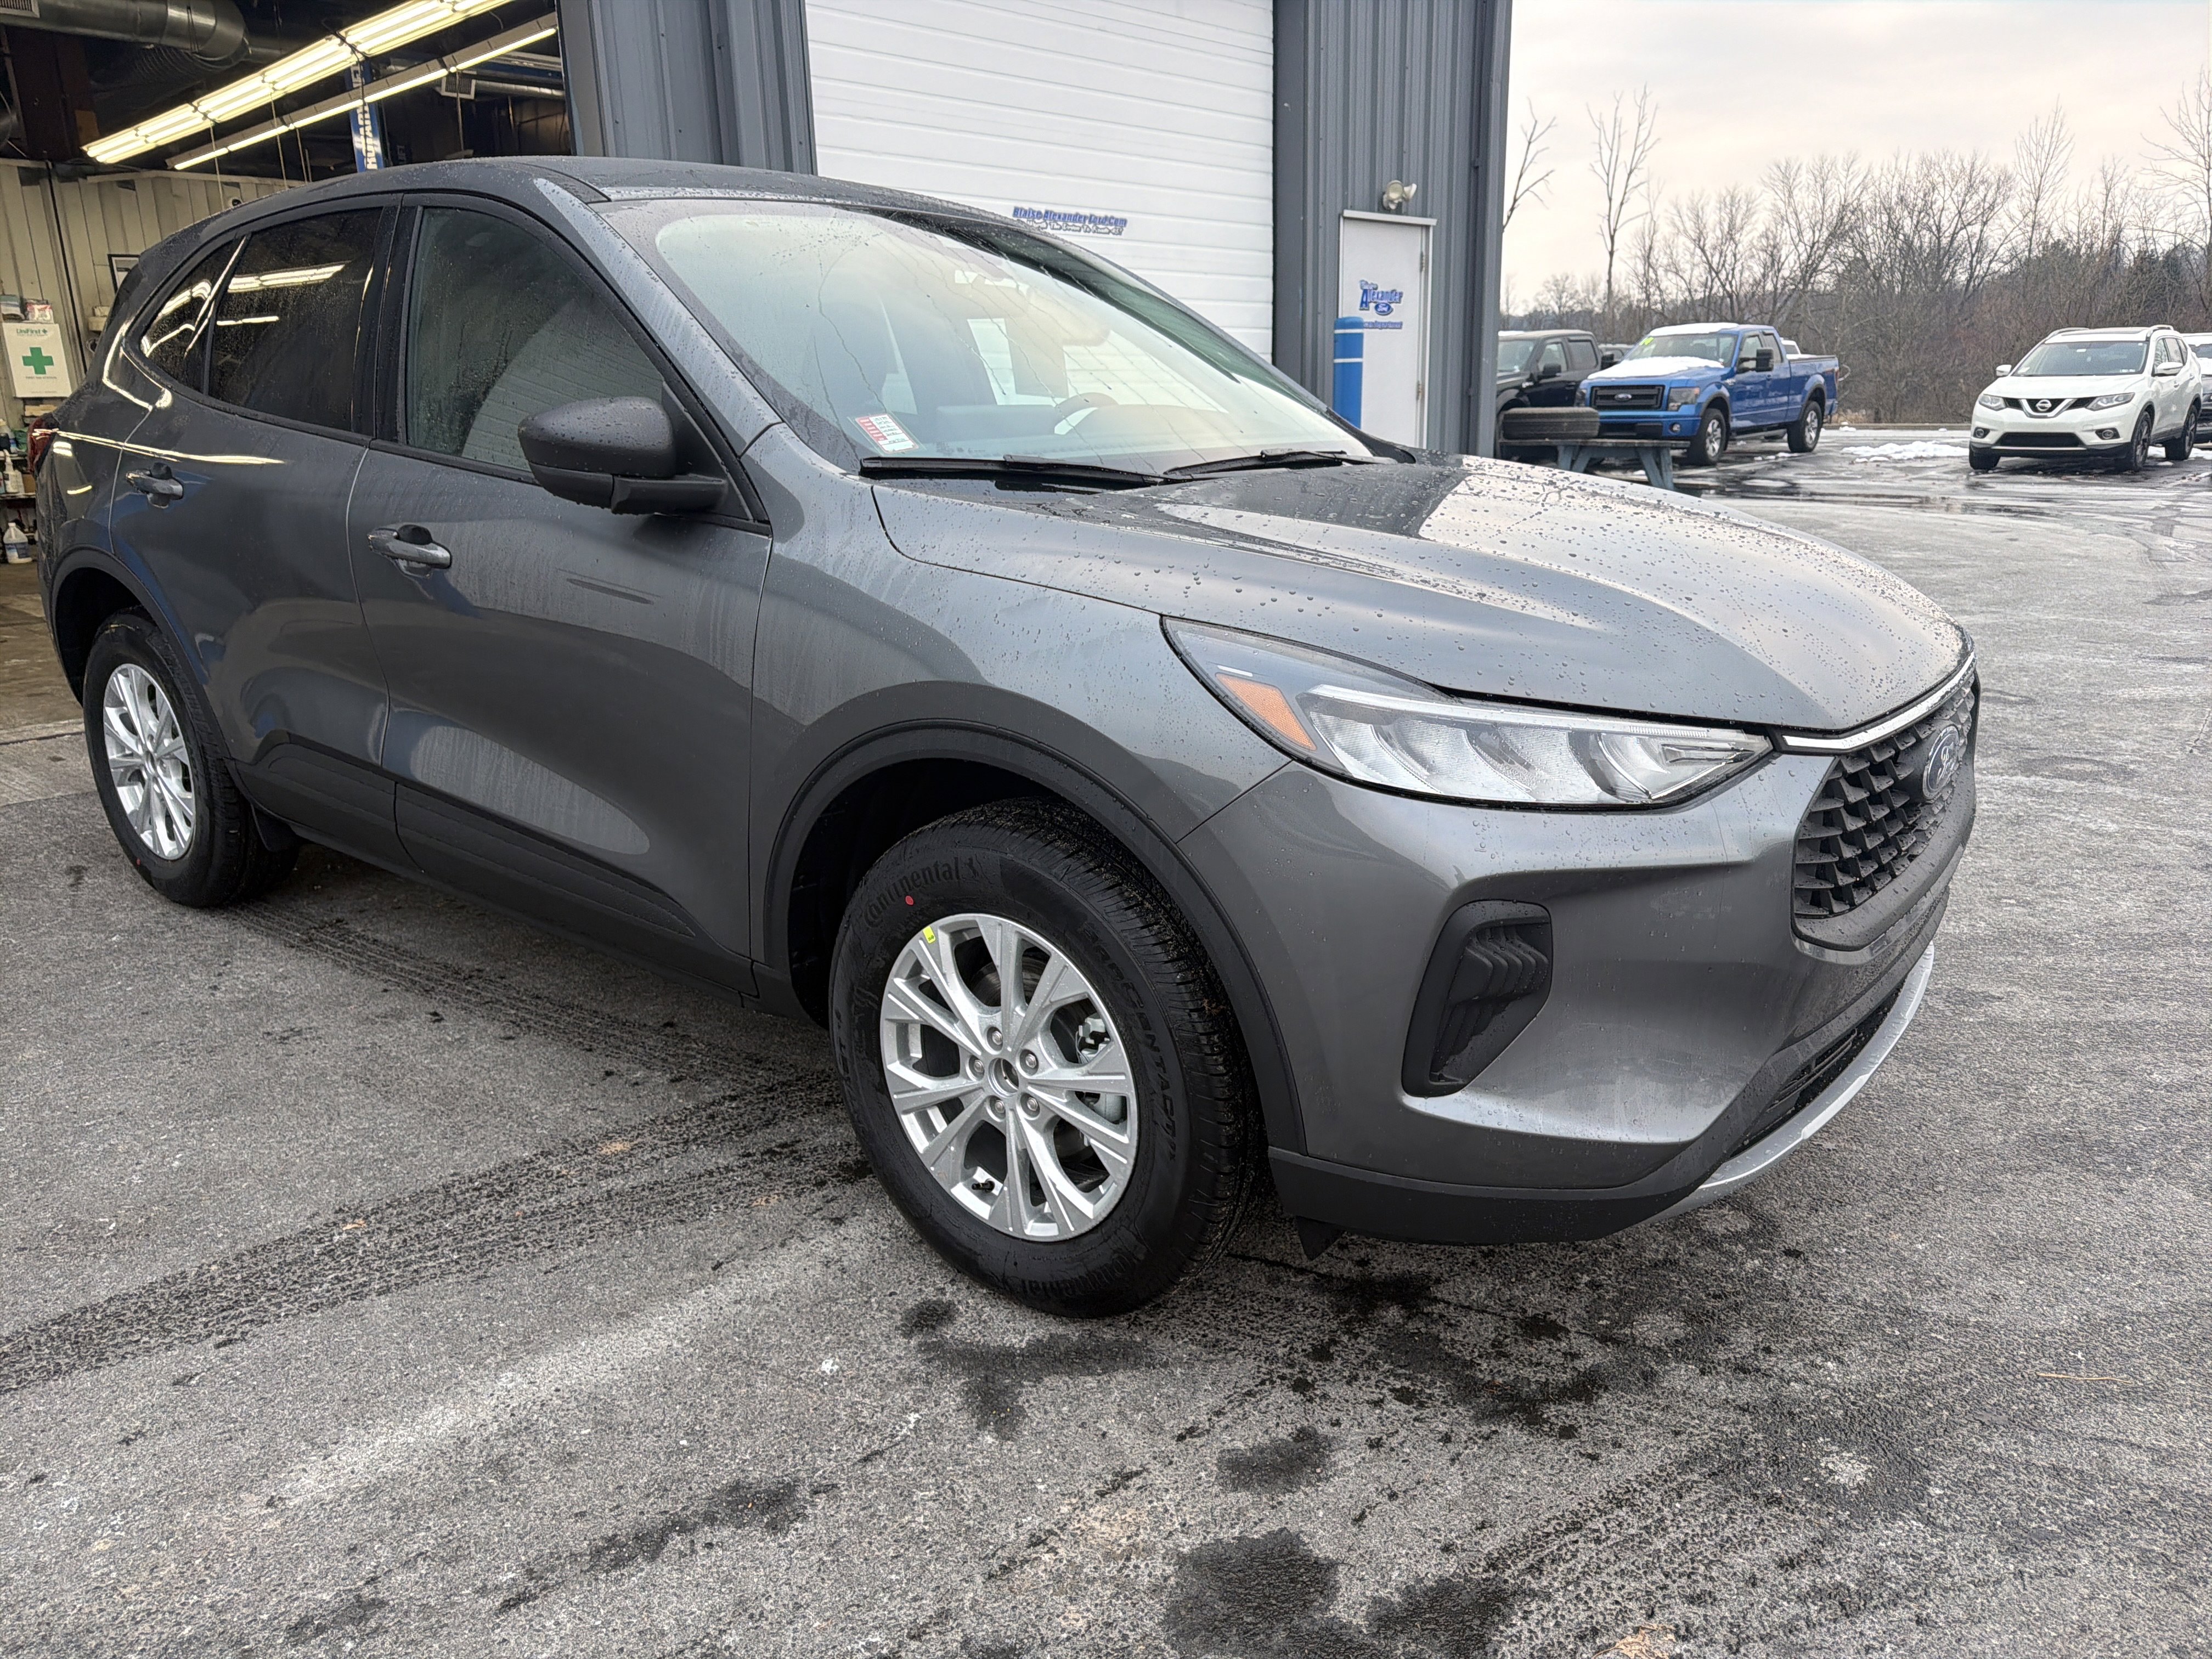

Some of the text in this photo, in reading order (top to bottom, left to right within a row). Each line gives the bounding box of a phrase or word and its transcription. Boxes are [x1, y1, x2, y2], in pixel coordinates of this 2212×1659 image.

[1013, 206, 1043, 219] Blaise
[1043, 210, 1088, 224] Alexander
[1359, 289, 1403, 311] Alexander
[864, 856, 961, 928] Continental
